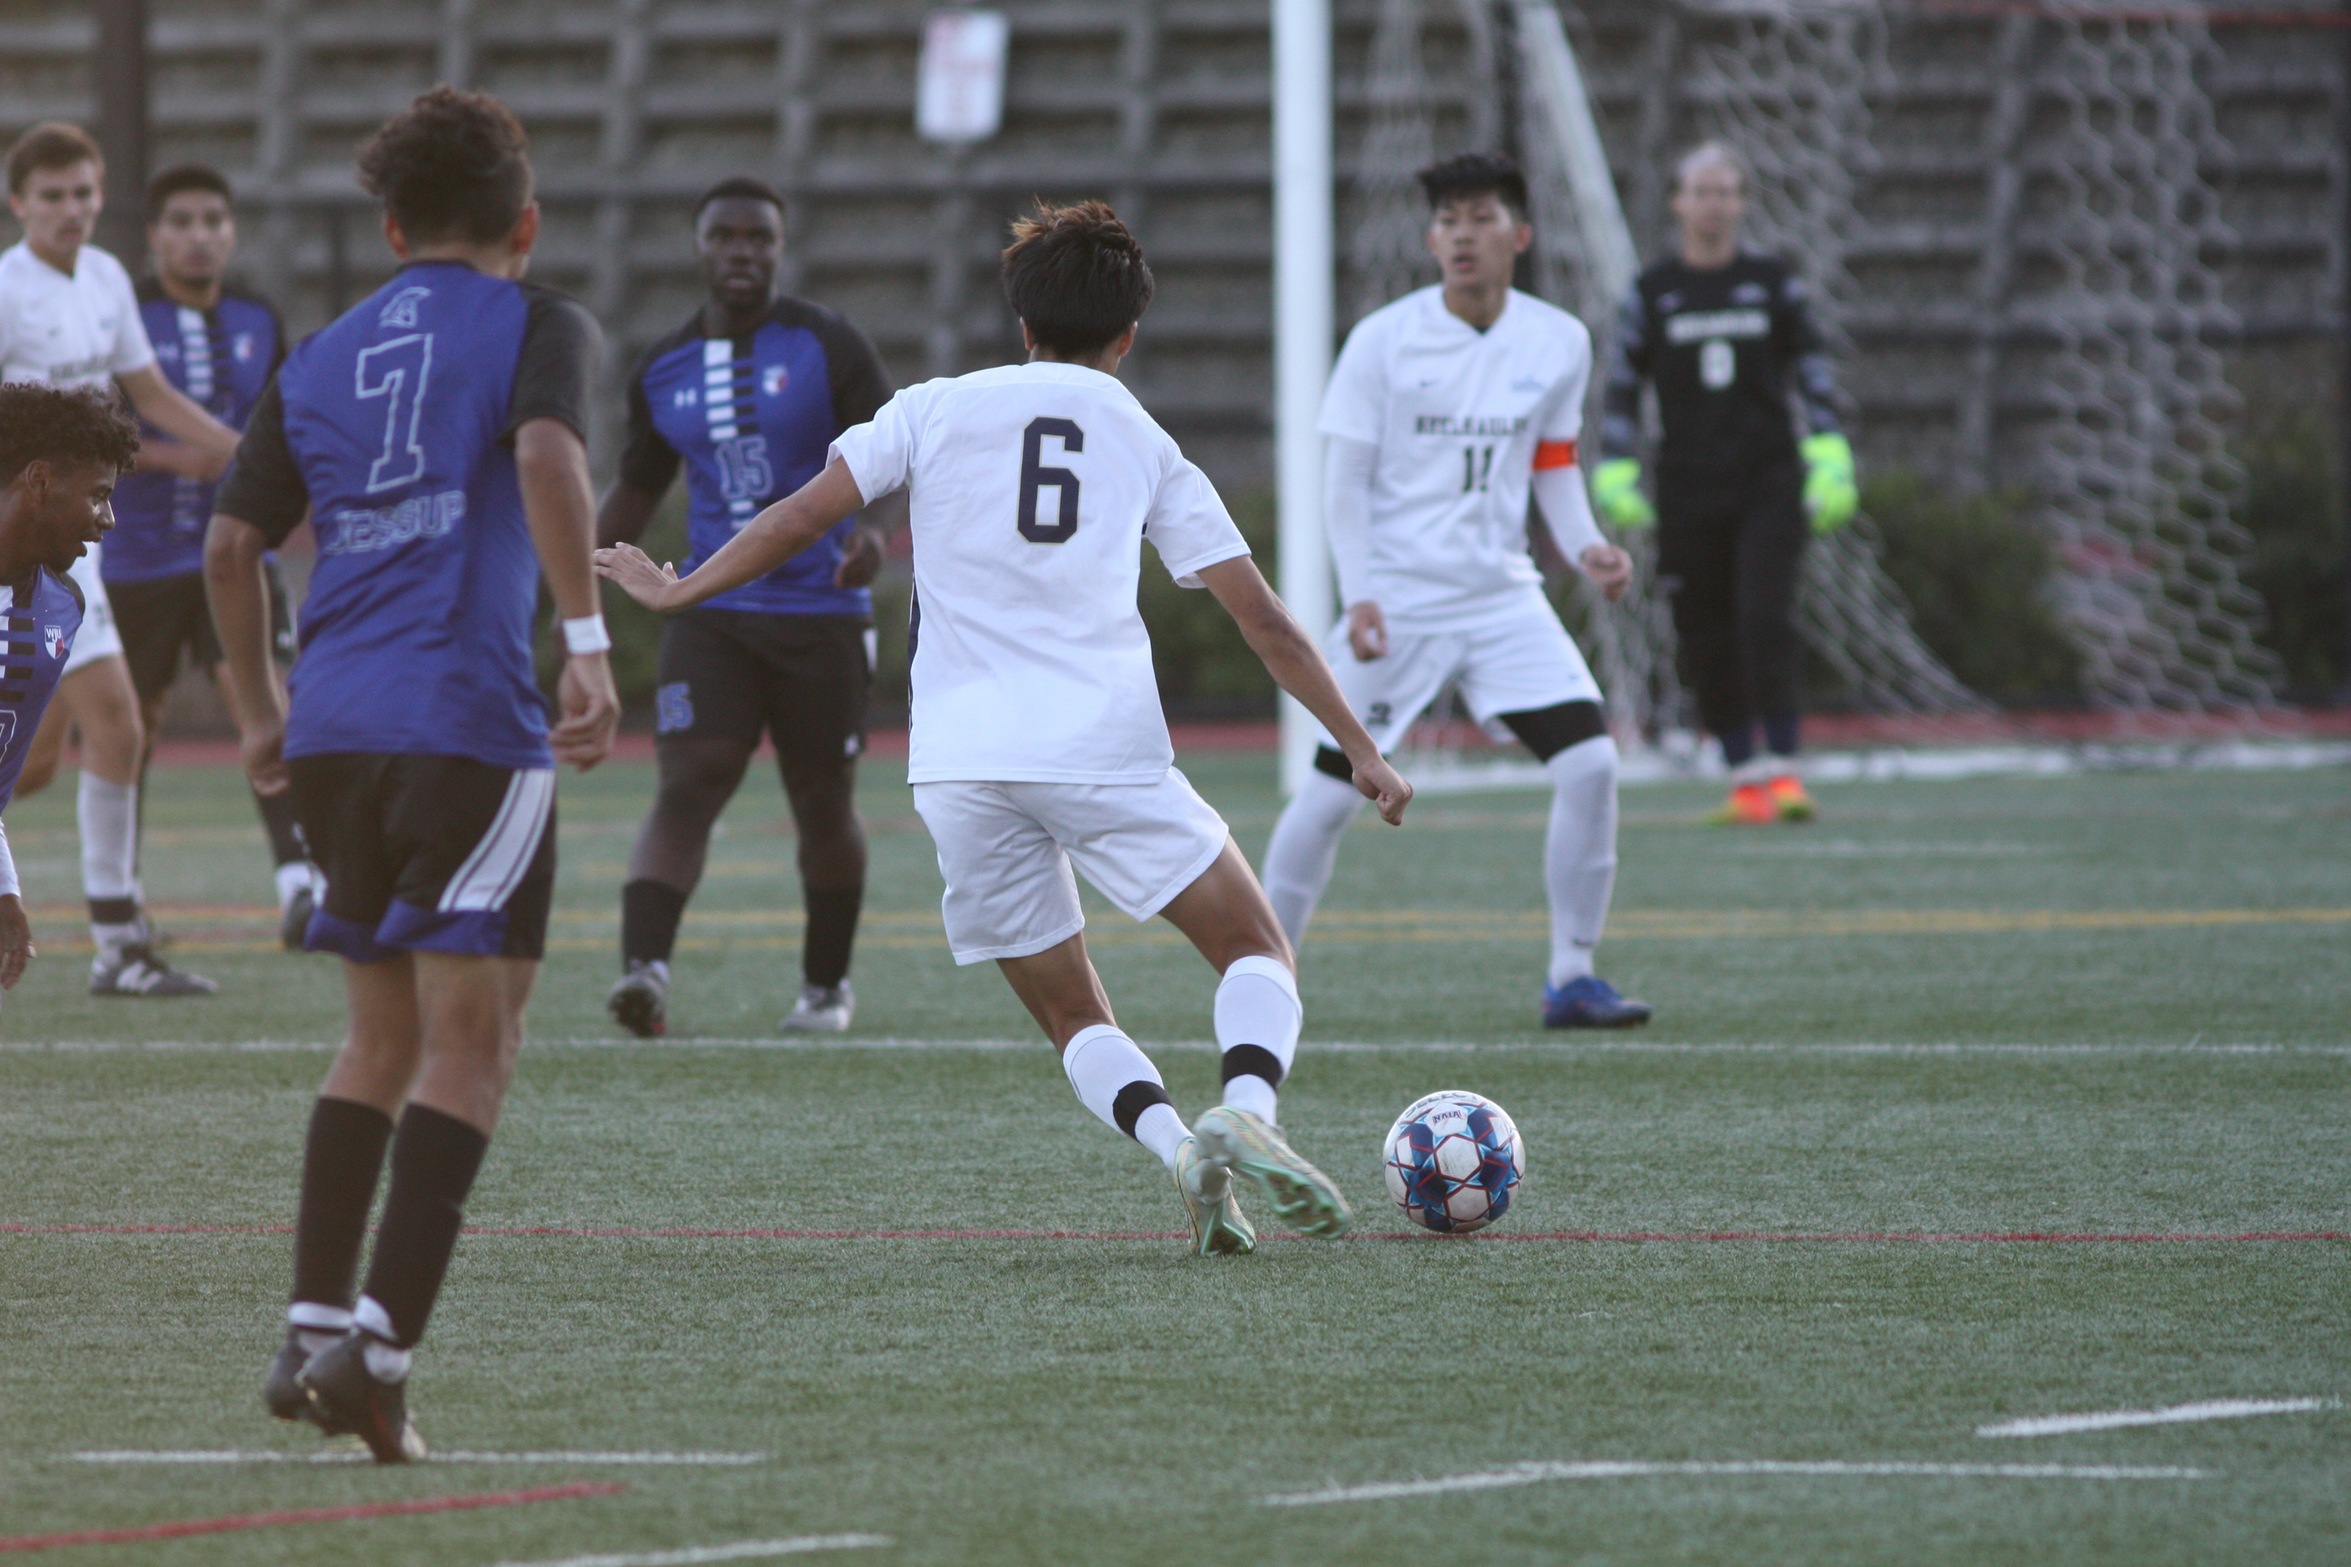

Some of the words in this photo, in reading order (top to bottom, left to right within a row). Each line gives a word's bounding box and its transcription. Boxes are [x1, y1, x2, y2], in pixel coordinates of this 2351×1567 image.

[355, 333, 434, 494] 7
[715, 434, 774, 499] 15
[1017, 415, 1085, 545] 6
[1461, 445, 1495, 494] 11
[325, 490, 466, 555] JESSUP
[46, 628, 62, 642] WJU
[655, 682, 694, 734] 15
[1431, 1110, 1463, 1124] NAIA
